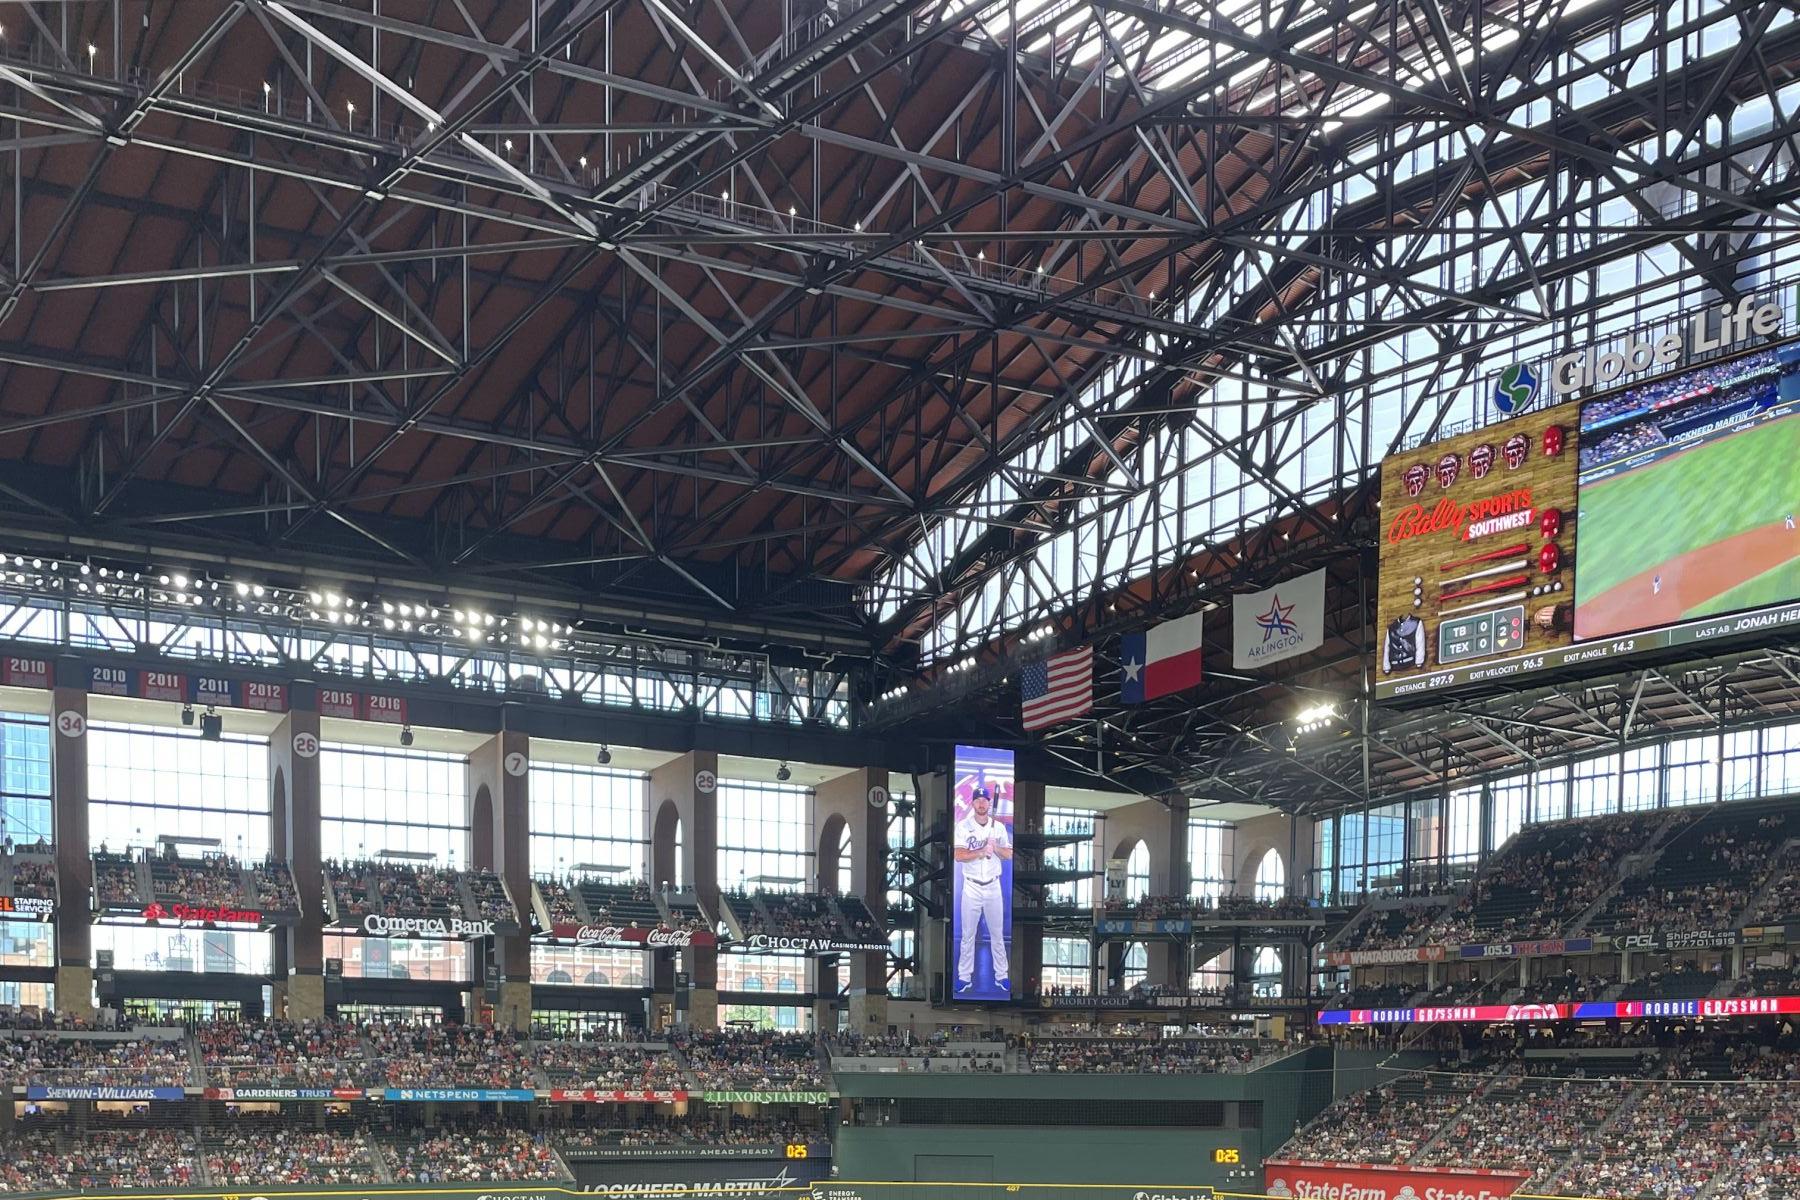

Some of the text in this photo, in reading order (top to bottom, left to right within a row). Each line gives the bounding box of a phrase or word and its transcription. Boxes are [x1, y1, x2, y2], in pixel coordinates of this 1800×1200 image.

[1551, 294, 1782, 394] Globe Life
[1715, 412, 1748, 430] MARTIN
[1470, 488, 1532, 522] SPORTS
[1387, 496, 1467, 544] Bally
[1469, 510, 1532, 538] SOUTHWEST
[1453, 626, 1466, 637] TB
[1500, 627, 1507, 636] 2
[1696, 628, 1716, 638] LAST
[1718, 625, 1730, 634] AB
[1734, 612, 1778, 631] JONAH
[1248, 634, 1304, 658] ARLINGTON
[1450, 642, 1469, 654] TEX
[1564, 640, 1634, 662] EXIT ANGLE 14.3
[10, 658, 46, 674] 2010
[1470, 658, 1544, 680] EXIT VELOCITY 96.5
[92, 668, 126, 682] 2010
[148, 672, 178, 688] 2011
[199, 678, 229, 693] 2011
[250, 683, 281, 698] 2012
[1395, 674, 1454, 694] DISTANCE 297.9
[322, 691, 352, 705] 2015
[370, 696, 400, 710] 2016
[61, 717, 82, 732] 34
[296, 738, 315, 751] 26
[512, 758, 521, 770] 7
[698, 774, 714, 789] 29
[870, 790, 884, 804] 10
[14, 898, 53, 907] STAFFING
[15, 905, 52, 913] SERVICES
[450, 918, 495, 935] Bank
[757, 934, 831, 950] CHOCTAW
[1625, 935, 1659, 947] PGL
[1351, 949, 1419, 964] WHATABURGER
[1483, 945, 1512, 956] 105.3
[1054, 998, 1128, 1006] PRIORITY GOLD
[1157, 997, 1223, 1006] HART HVAC
[1626, 1003, 1632, 1014] 4
[1646, 1002, 1693, 1014] ROBBIE
[1358, 1011, 1363, 1022] 4
[1373, 1010, 1411, 1022] ROBBIE
[236, 1088, 298, 1098] GARDENERS
[300, 1089, 331, 1098] TRUST
[416, 1091, 479, 1099] NETSPEND
[717, 1092, 827, 1103] LUXOR STAFFING
